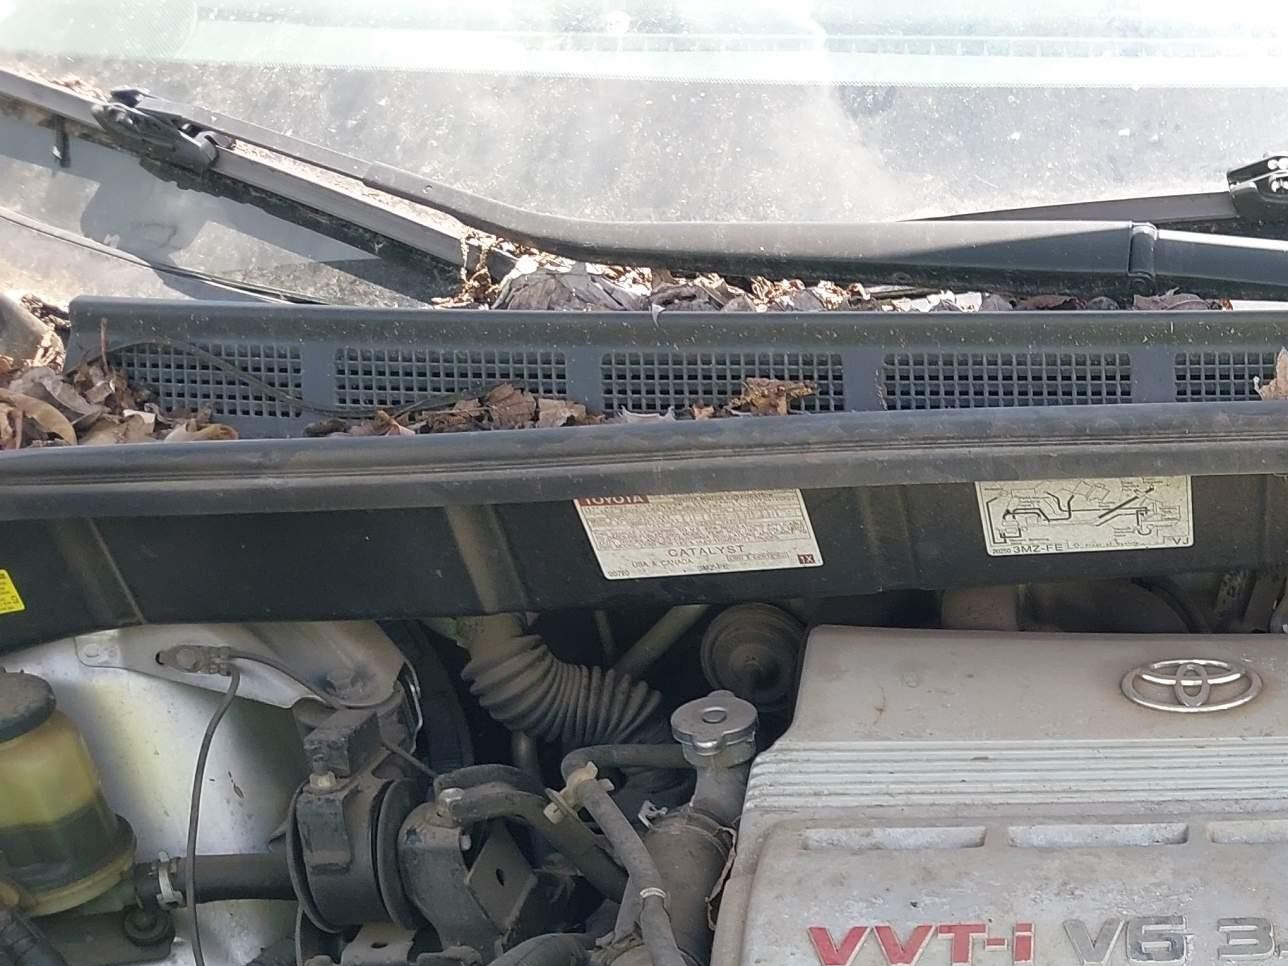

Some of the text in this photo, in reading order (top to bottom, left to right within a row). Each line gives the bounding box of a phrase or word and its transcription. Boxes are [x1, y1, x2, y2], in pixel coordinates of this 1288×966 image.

[1172, 536, 1189, 545] VJ
[667, 544, 746, 558] CATALYST
[1013, 544, 1065, 554] 3MZ-FE
